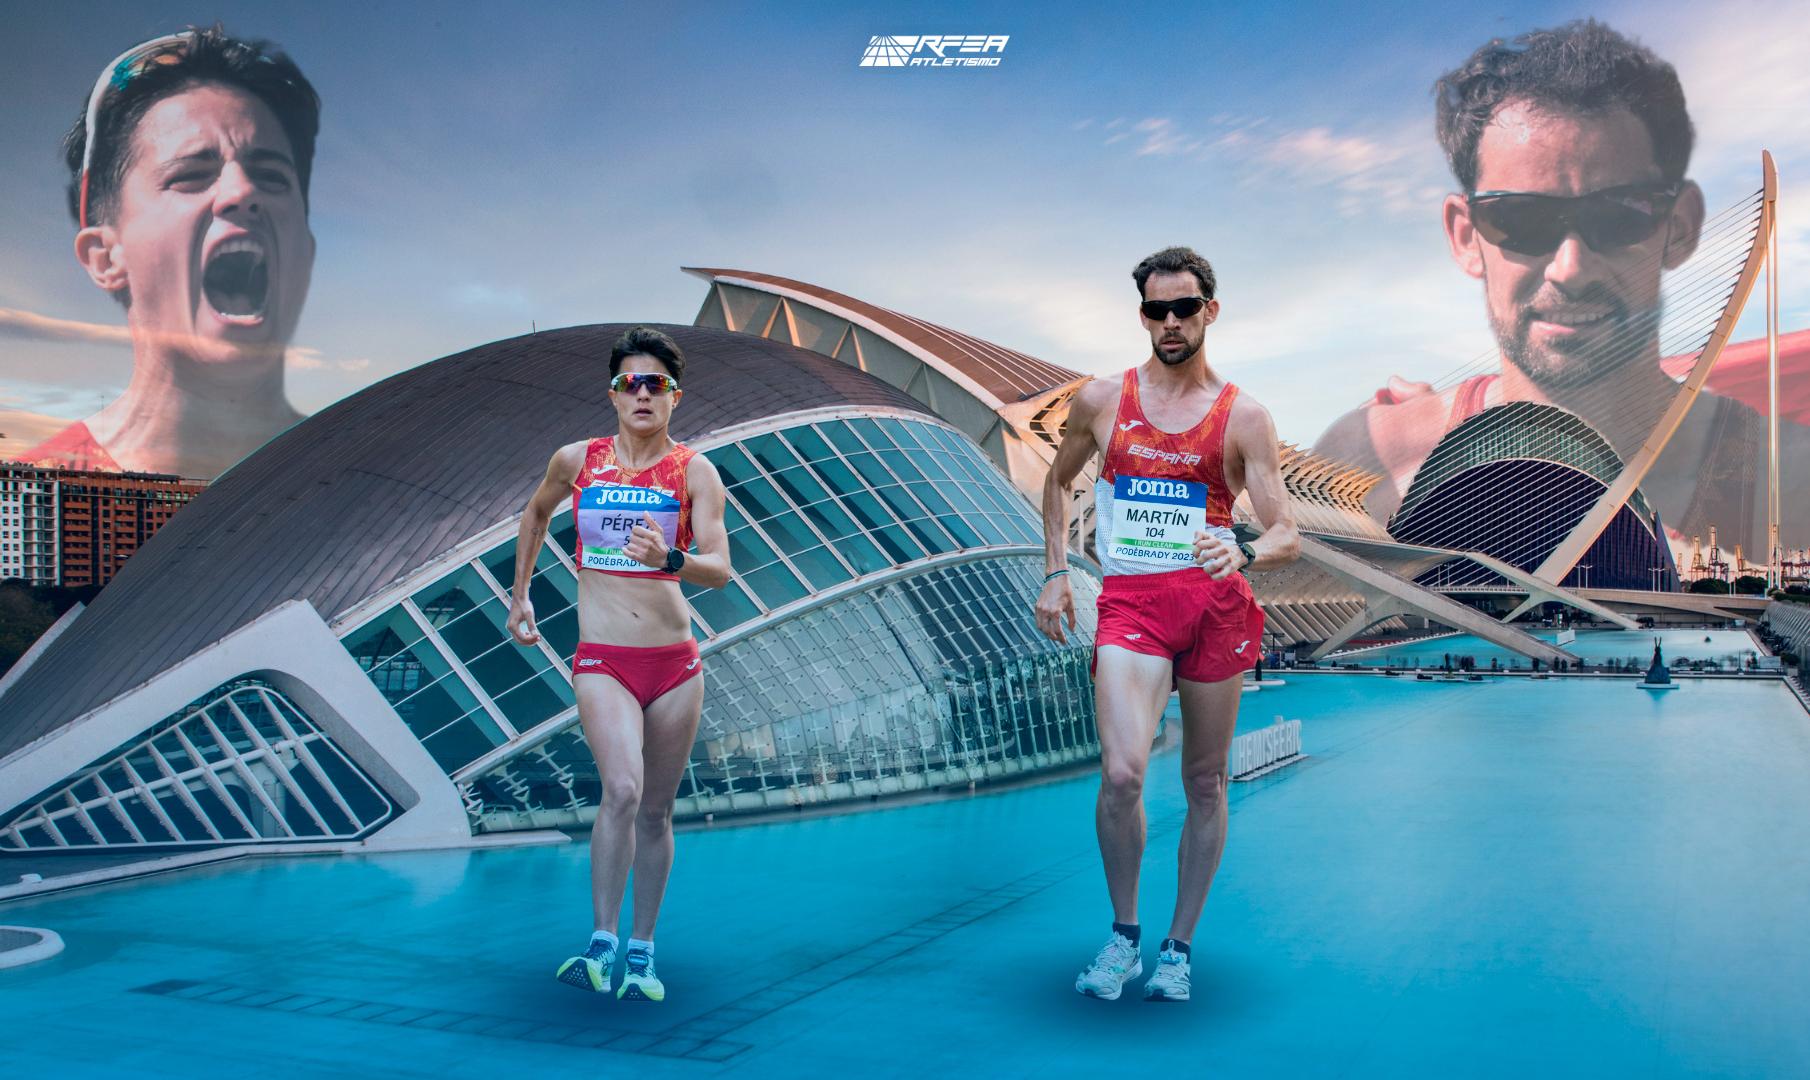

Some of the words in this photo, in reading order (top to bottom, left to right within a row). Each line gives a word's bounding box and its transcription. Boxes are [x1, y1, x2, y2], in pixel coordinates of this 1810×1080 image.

[1127, 443, 1202, 466] ESPAÑA
[601, 513, 655, 531] PÉRE
[1126, 508, 1190, 526] MARTÍN
[1145, 527, 1165, 538] 104
[1152, 541, 1174, 549] CLEAN
[1171, 552, 1194, 561] 2023
